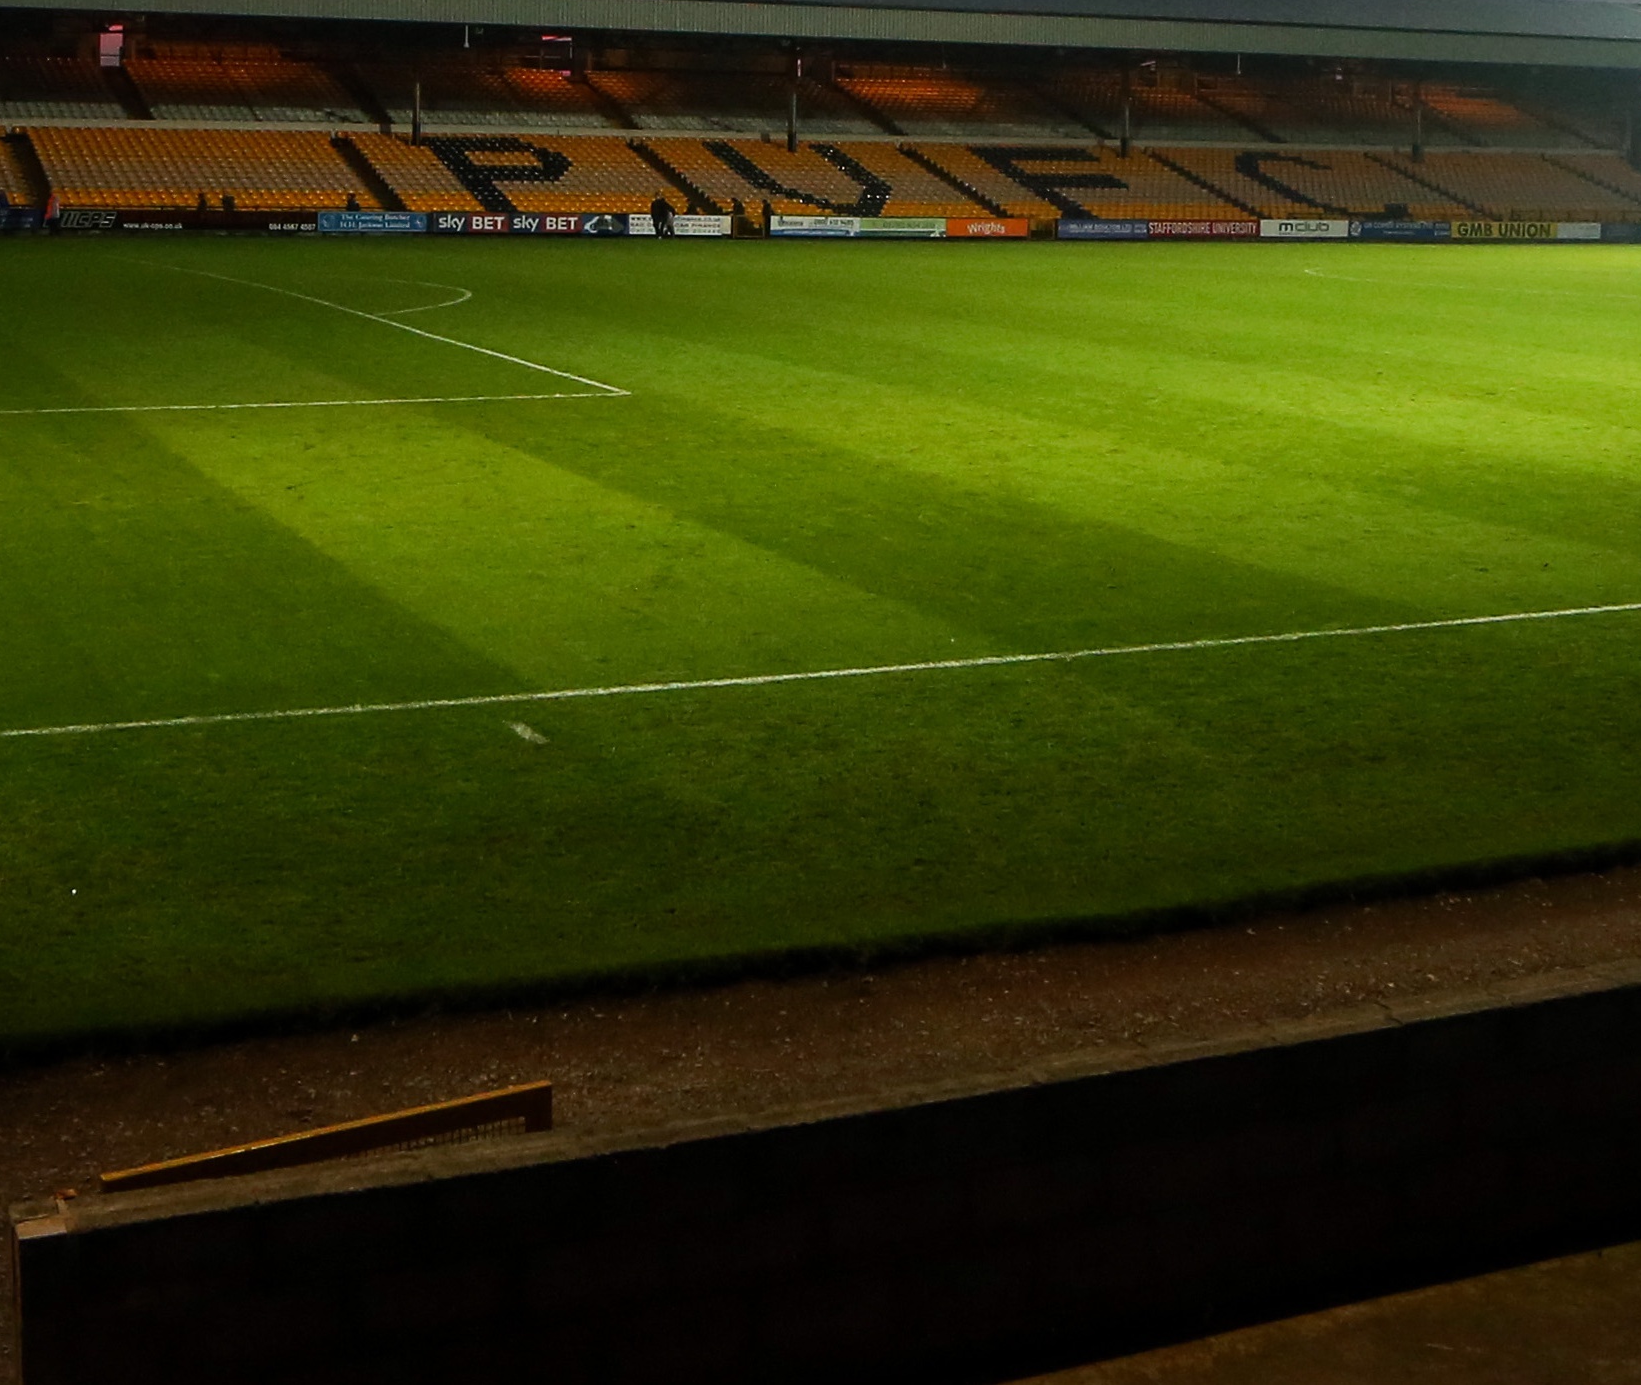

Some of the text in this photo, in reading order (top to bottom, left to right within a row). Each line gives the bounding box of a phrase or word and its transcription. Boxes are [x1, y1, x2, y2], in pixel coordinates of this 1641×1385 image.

[439, 215, 506, 232] sky BET
[513, 216, 579, 232] sky BET
[1149, 222, 1210, 234] STAFFORDSHIRE
[1212, 223, 1258, 234] UNIVERSITY
[1457, 223, 1493, 236] GMB
[1497, 224, 1552, 238] UNION
